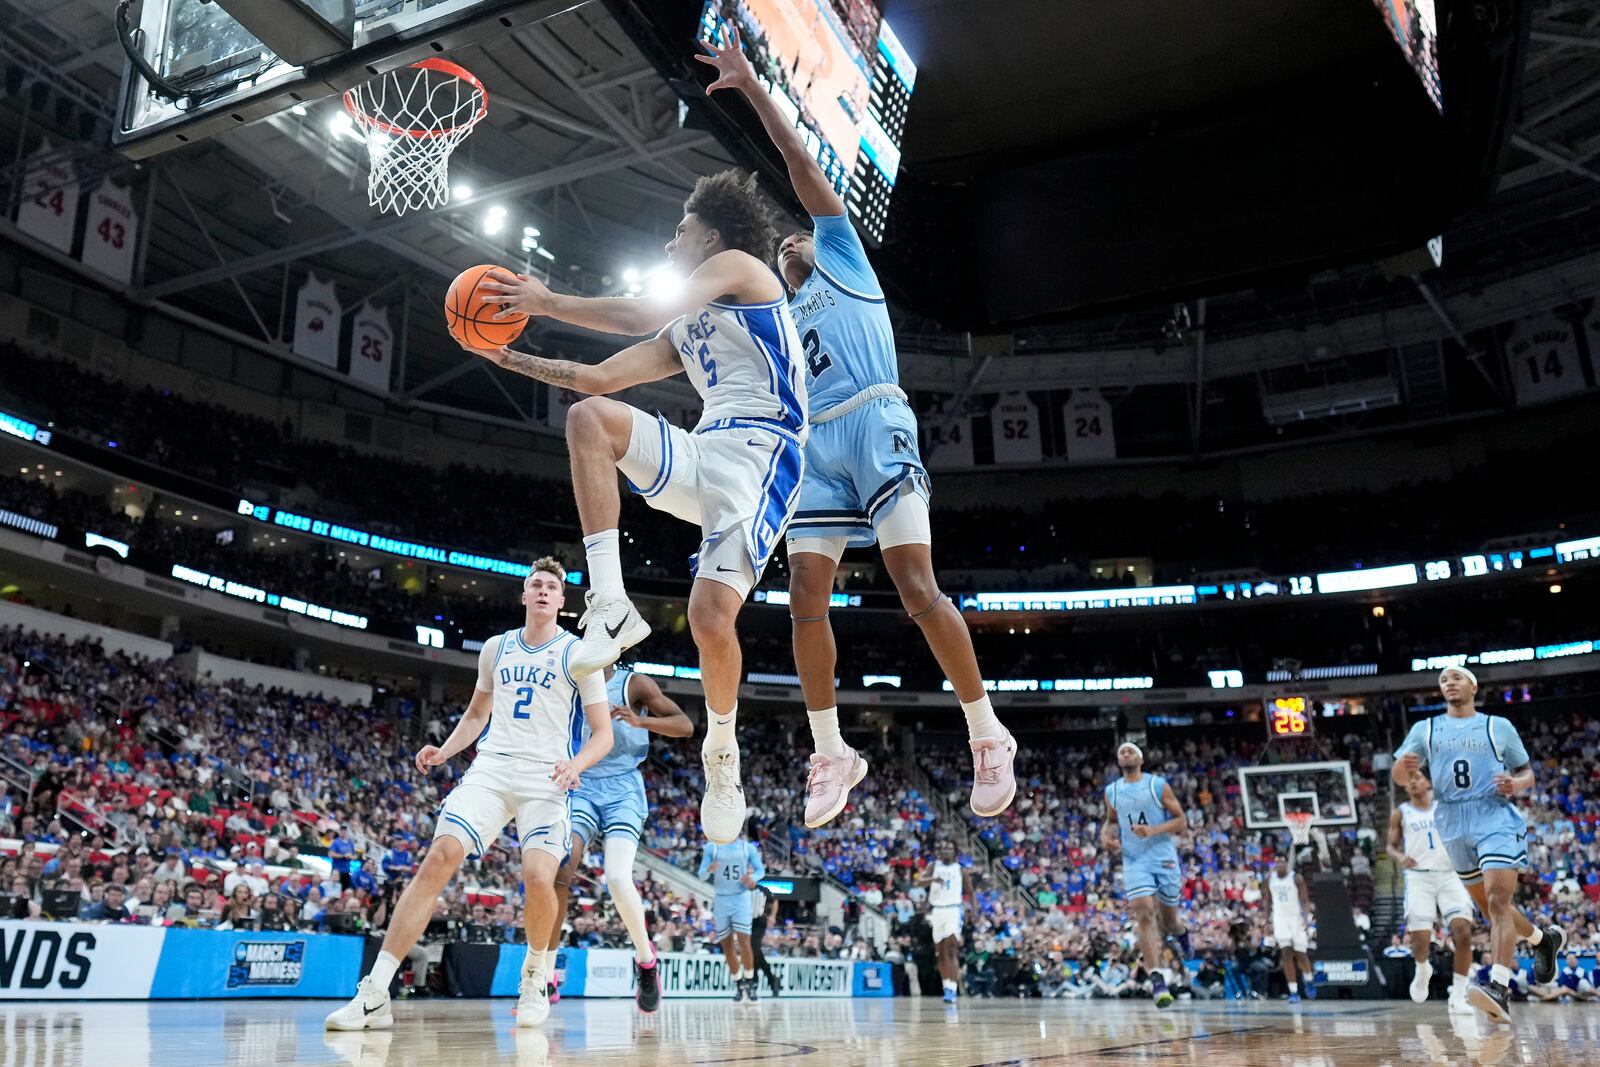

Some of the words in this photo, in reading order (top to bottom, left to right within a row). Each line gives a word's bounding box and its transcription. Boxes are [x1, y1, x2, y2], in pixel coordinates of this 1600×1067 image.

[98, 218, 125, 249] 43
[799, 290, 835, 320] MARY'S
[361, 335, 382, 362] 25
[698, 342, 718, 388] 5
[1527, 350, 1563, 383] 14
[1003, 420, 1029, 439] 52
[1075, 417, 1102, 437] 24
[275, 511, 311, 531] 2025
[312, 521, 330, 535] DI
[330, 525, 369, 545] MEN'S
[370, 535, 447, 563] BASKETBALL
[1289, 576, 1313, 595] 12
[500, 666, 557, 689] DUKE
[513, 687, 534, 719] 2
[1274, 711, 1305, 733] 26
[1453, 760, 1471, 788] 8
[1427, 832, 1435, 849] 1
[723, 865, 740, 880] 45
[246, 944, 286, 961] MARCH
[248, 962, 302, 979] MADNESS
[788, 963, 848, 991] UNIVERSITY
